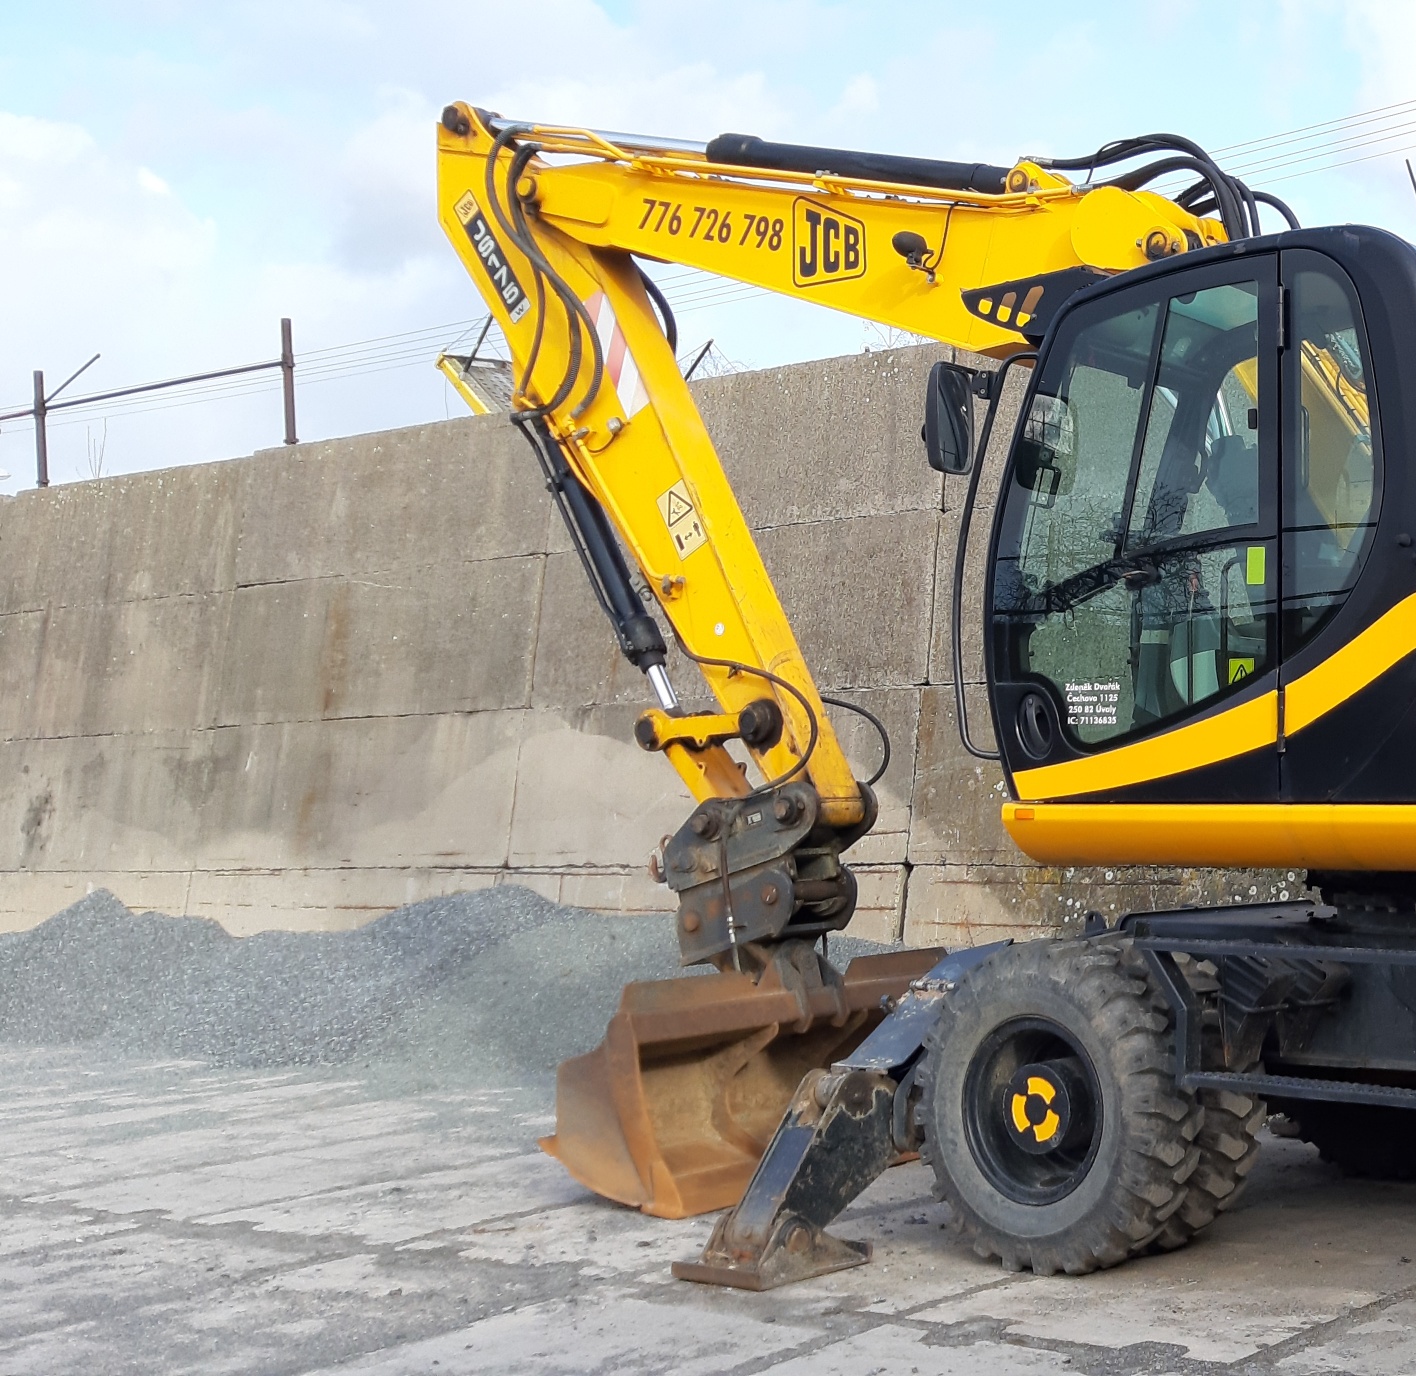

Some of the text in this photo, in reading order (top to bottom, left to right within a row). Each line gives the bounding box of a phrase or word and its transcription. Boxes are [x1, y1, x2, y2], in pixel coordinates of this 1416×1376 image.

[638, 198, 784, 251] 776 726 798
[799, 208, 860, 278] JCB
[1093, 682, 1121, 691] Dvořák
[1099, 693, 1119, 702] 1125
[1068, 705, 1083, 714] 250
[1084, 705, 1094, 714] 82
[1080, 716, 1117, 725] 71136835
